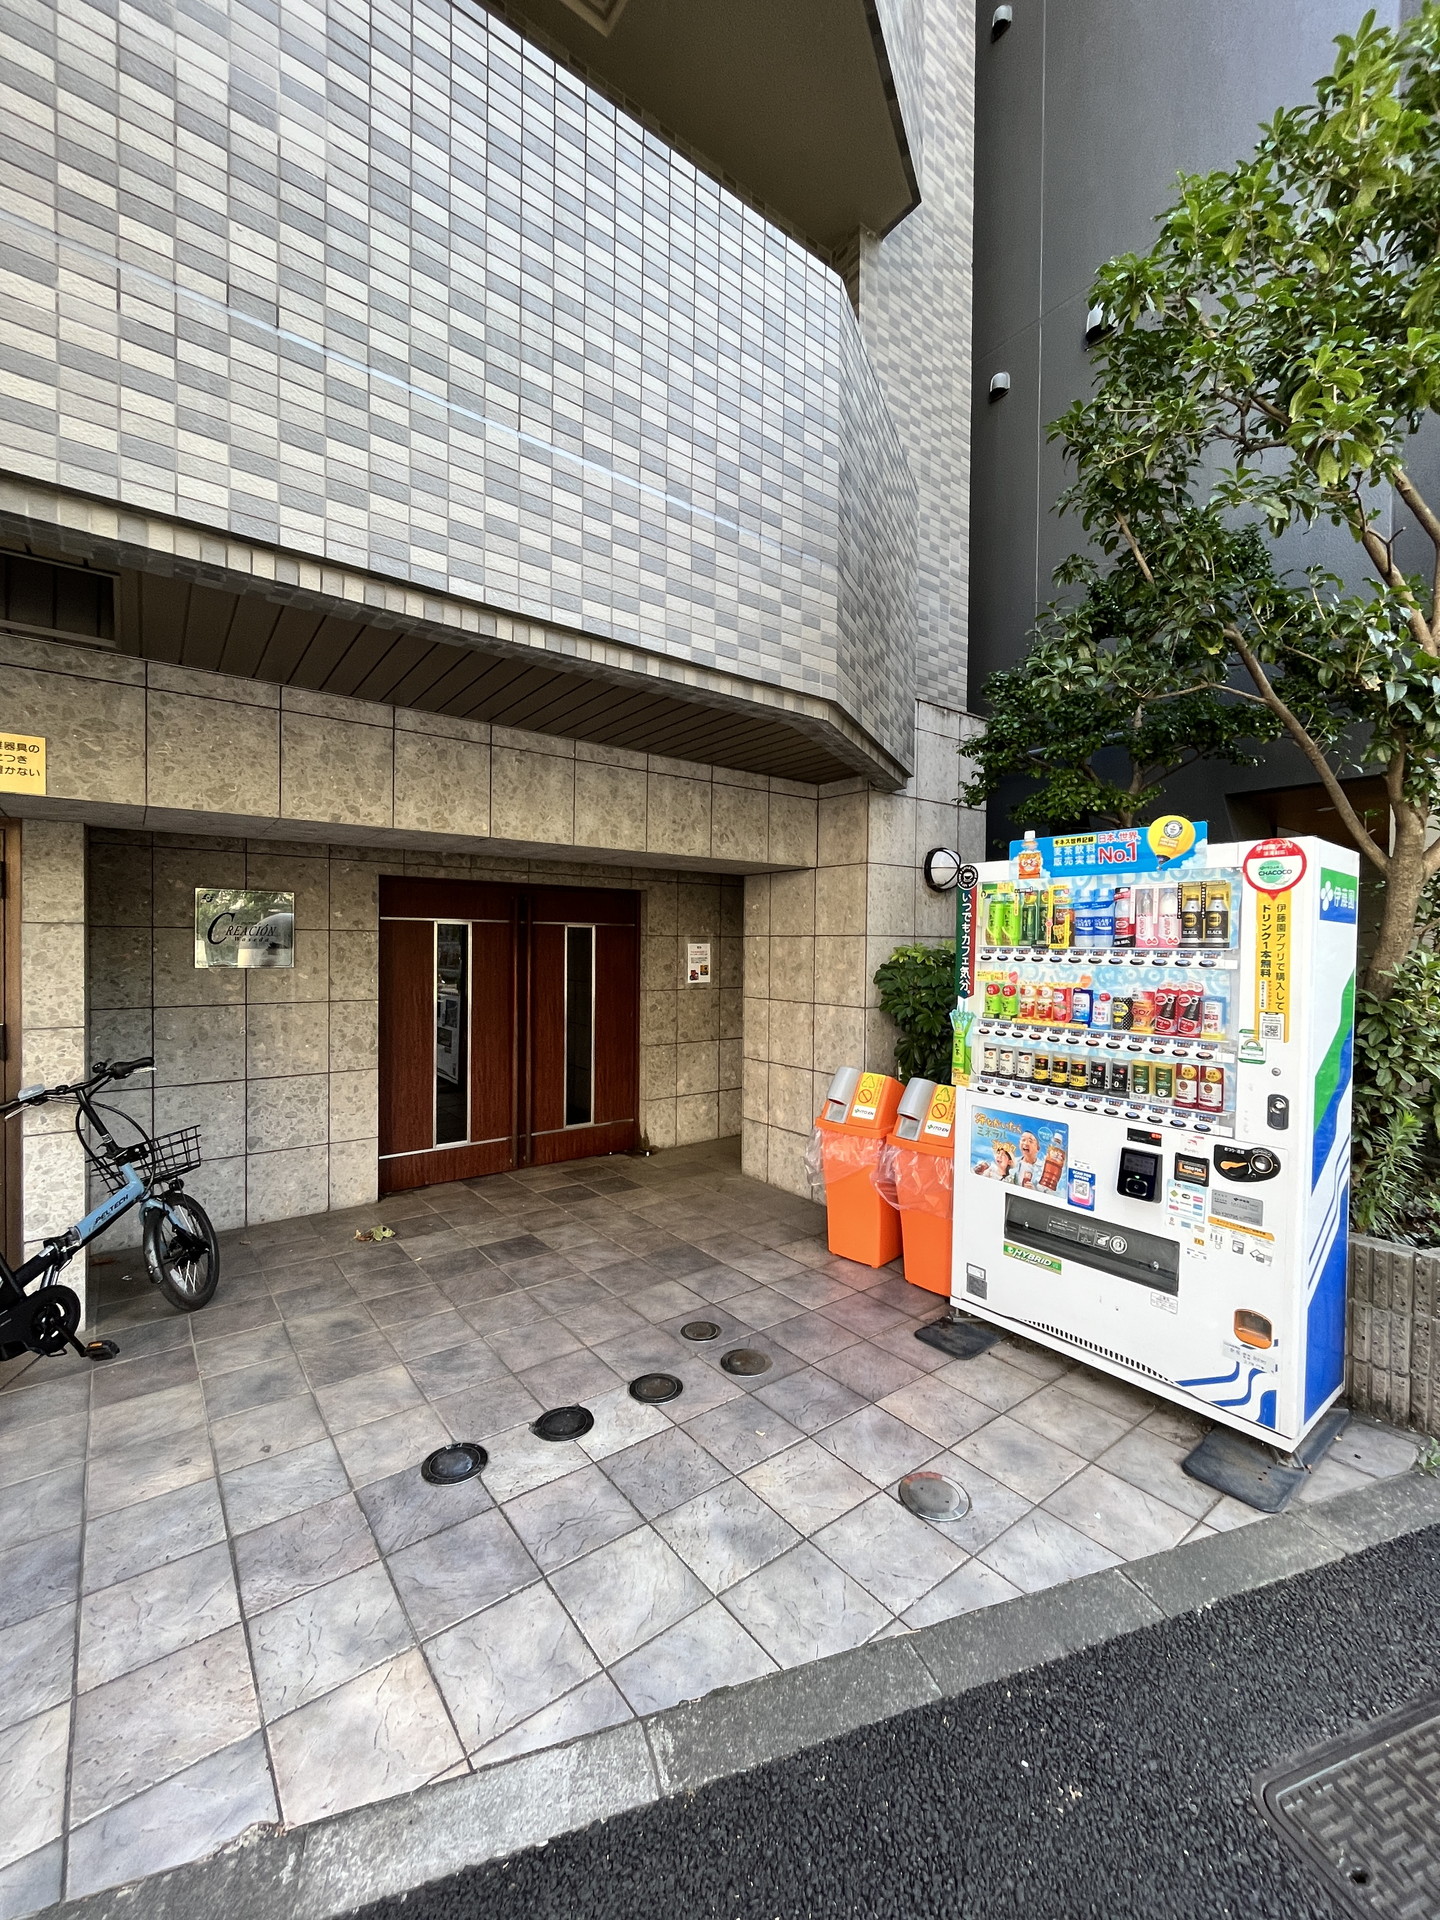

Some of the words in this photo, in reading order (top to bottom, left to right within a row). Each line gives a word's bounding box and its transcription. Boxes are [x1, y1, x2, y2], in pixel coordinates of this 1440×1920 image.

[0, 742, 40, 753] 器具の
[0, 754, 27, 765] つき
[0, 766, 40, 777] かない
[1098, 841, 1137, 864] No.1
[1333, 886, 1355, 909] 伊藤園
[1260, 904, 1271, 978] ドリンク1本無料
[1275, 903, 1286, 1010] 伊藤園アプリで購入して
[977, 1126, 1007, 1140] ミネラル
[94, 1194, 129, 1225] PELTECH
[1012, 1249, 1052, 1266] HYBRID
